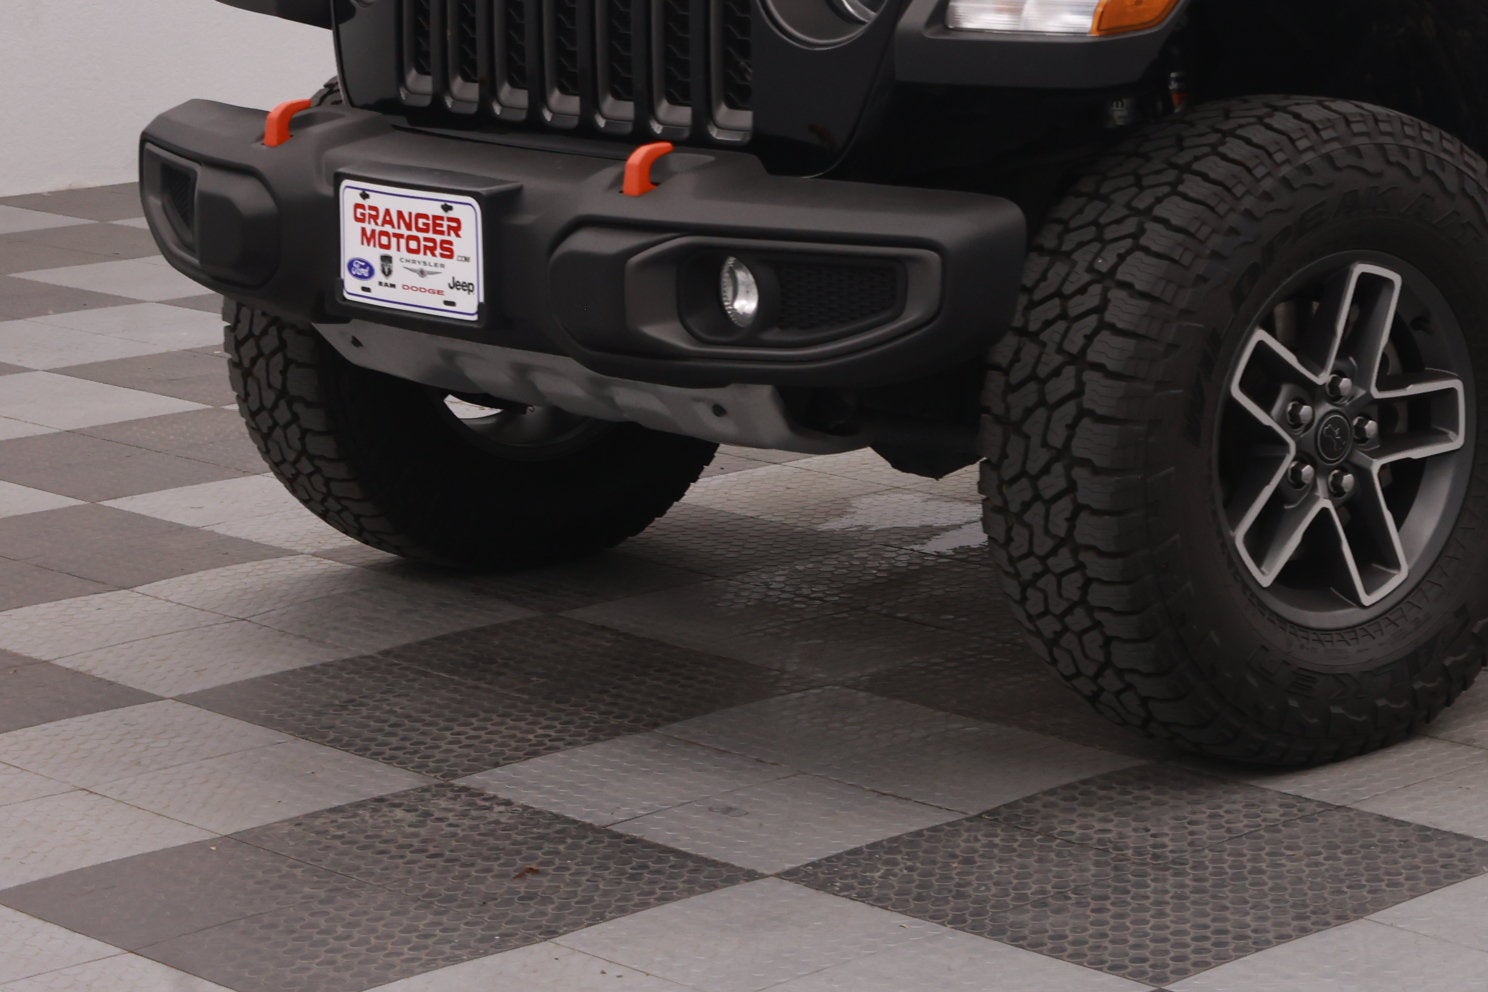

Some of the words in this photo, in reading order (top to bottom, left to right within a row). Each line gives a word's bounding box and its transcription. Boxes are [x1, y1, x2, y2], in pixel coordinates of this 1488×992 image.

[354, 203, 462, 238] GRANGER
[361, 227, 455, 259] MOTORS
[399, 257, 445, 268] CHRYSLER
[378, 281, 396, 289] RAM
[402, 284, 445, 295] DODGE
[448, 277, 475, 294] Jeep
